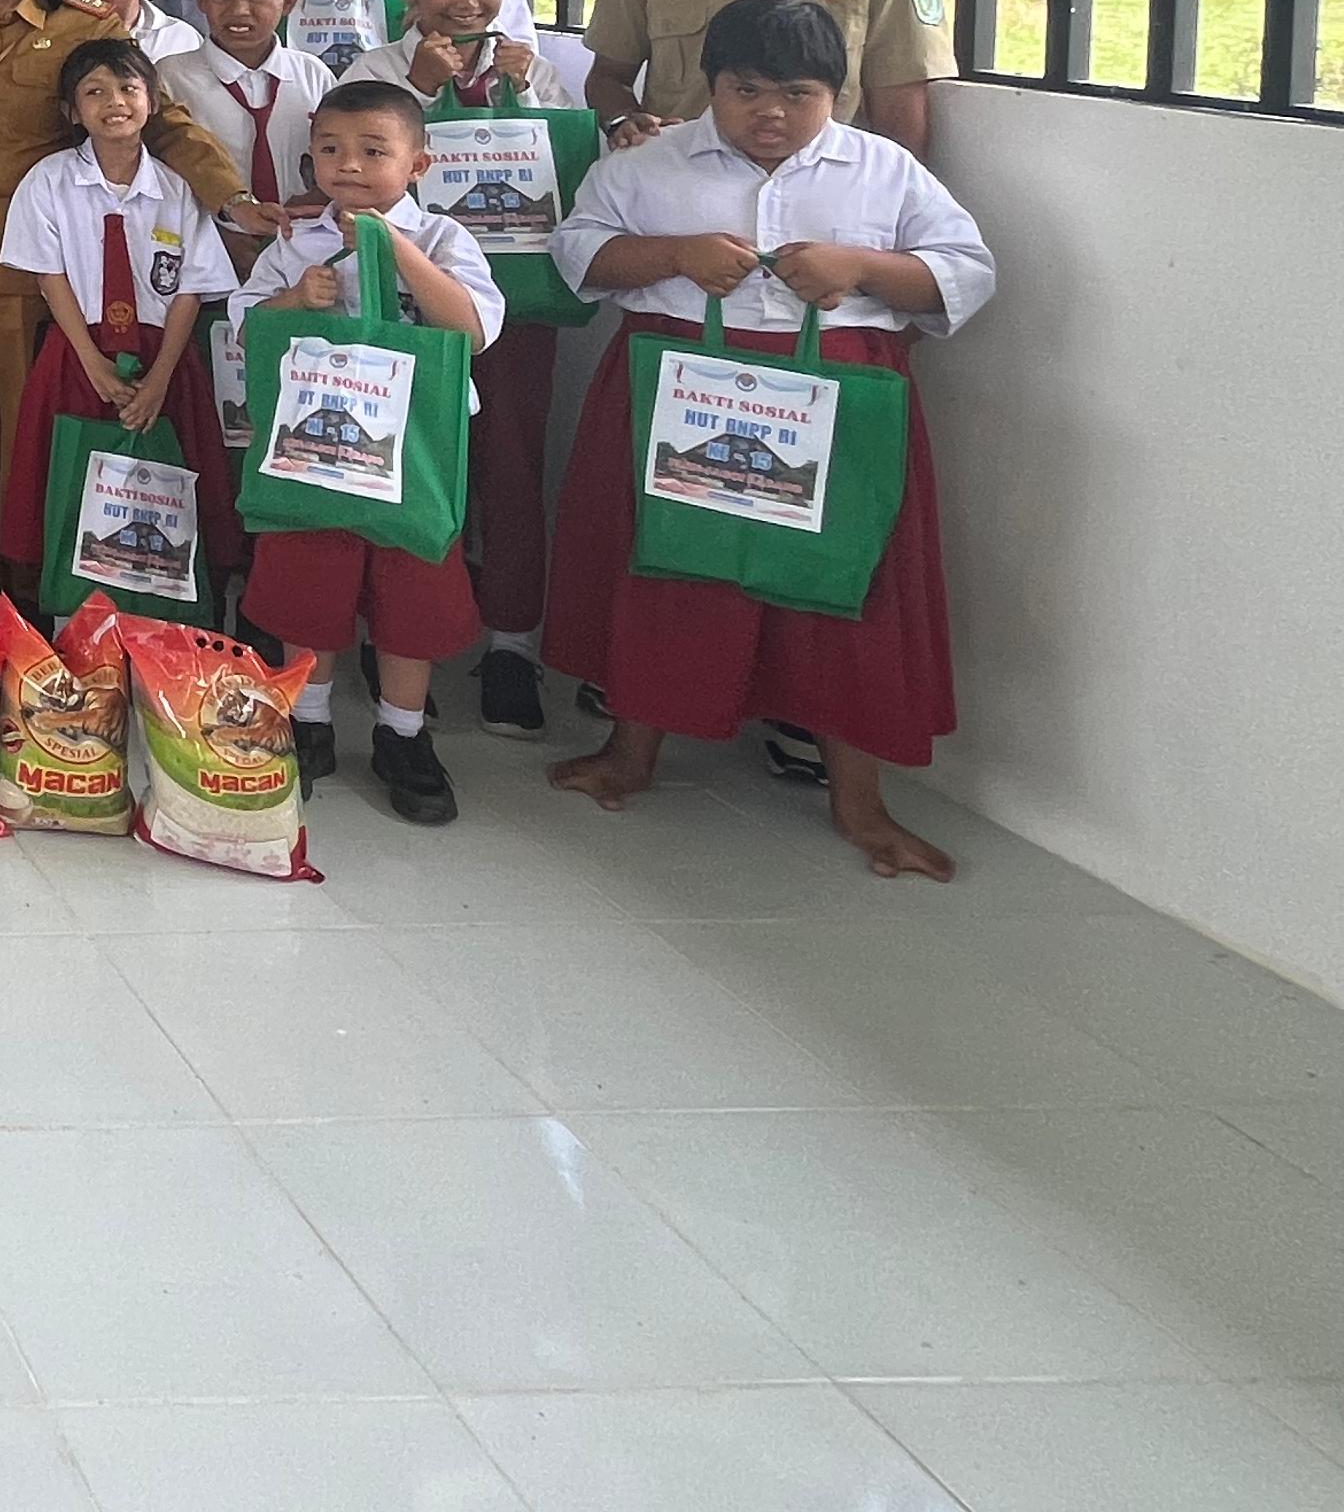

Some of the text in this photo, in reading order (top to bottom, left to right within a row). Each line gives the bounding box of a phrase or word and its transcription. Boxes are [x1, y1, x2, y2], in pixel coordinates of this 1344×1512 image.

[331, 375, 392, 399] SOSIAL
[672, 388, 812, 424] BAKTI SOSIAL
[683, 408, 721, 430] HUT
[725, 417, 773, 439] BNPP
